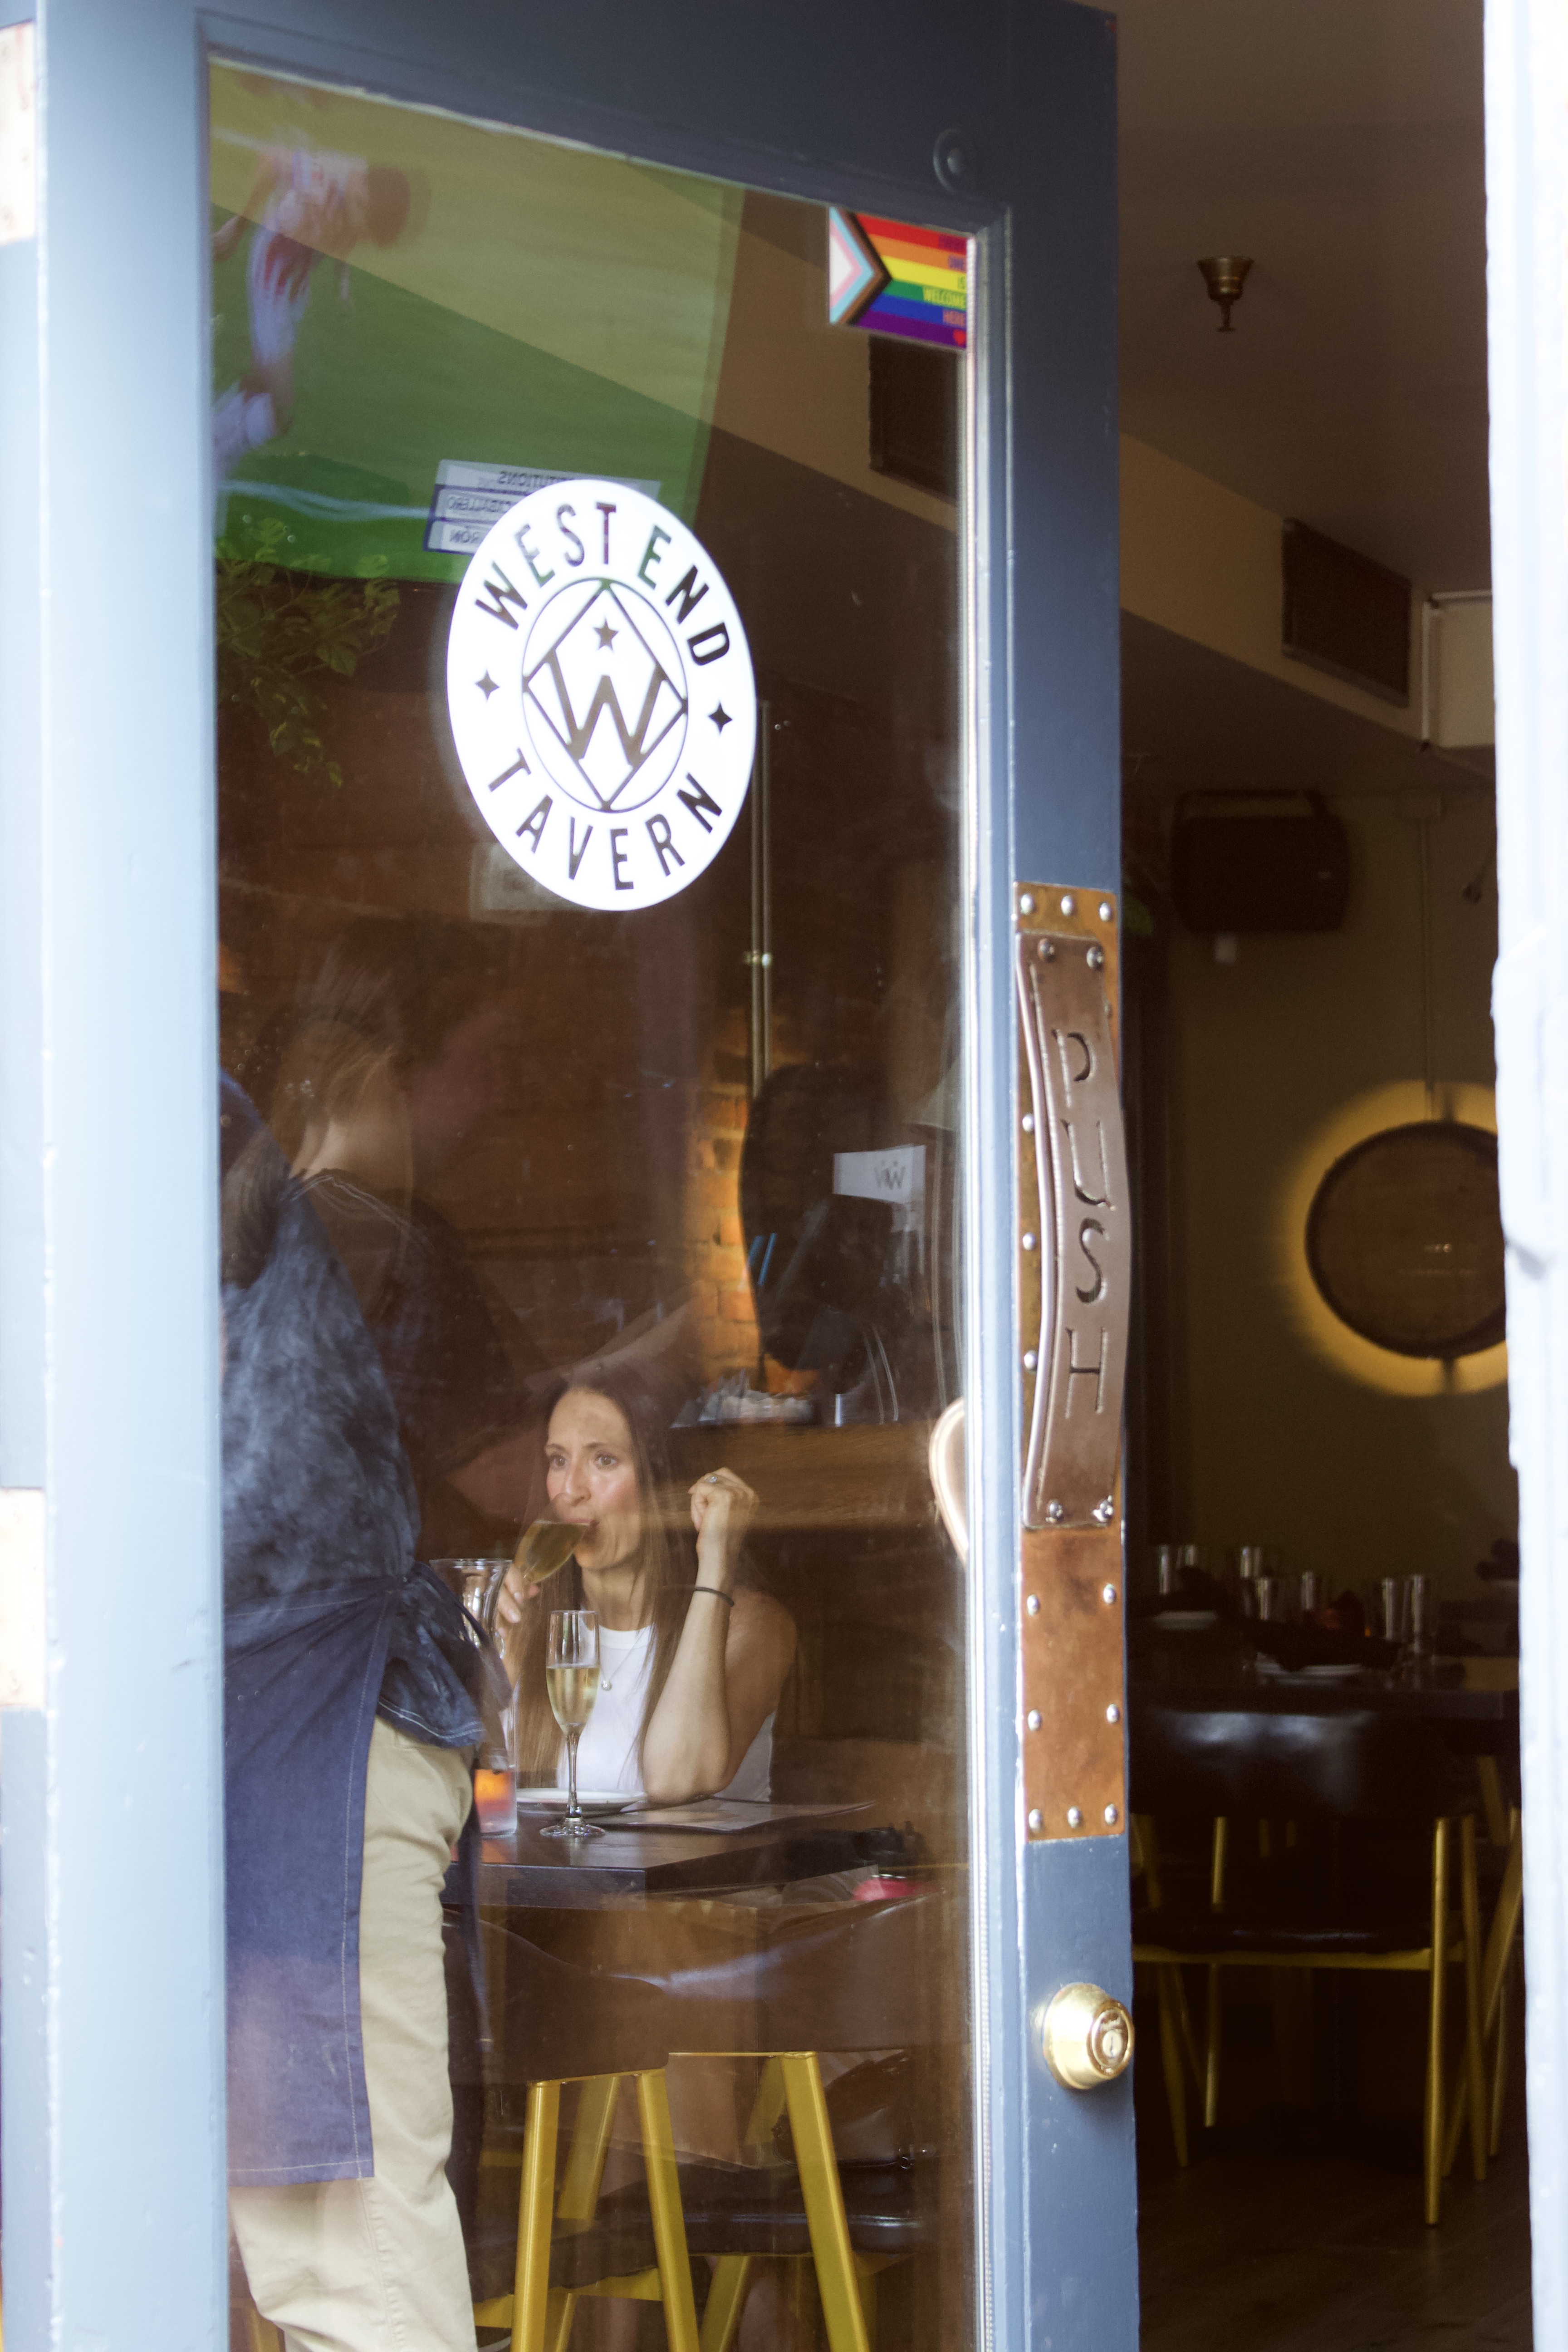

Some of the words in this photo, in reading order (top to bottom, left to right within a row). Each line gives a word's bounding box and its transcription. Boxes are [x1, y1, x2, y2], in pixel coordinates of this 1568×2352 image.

[475, 501, 617, 631] WEST
[637, 524, 730, 666] END
[488, 748, 723, 891] TAVERN
[1052, 1026, 1115, 1419] PUSH
